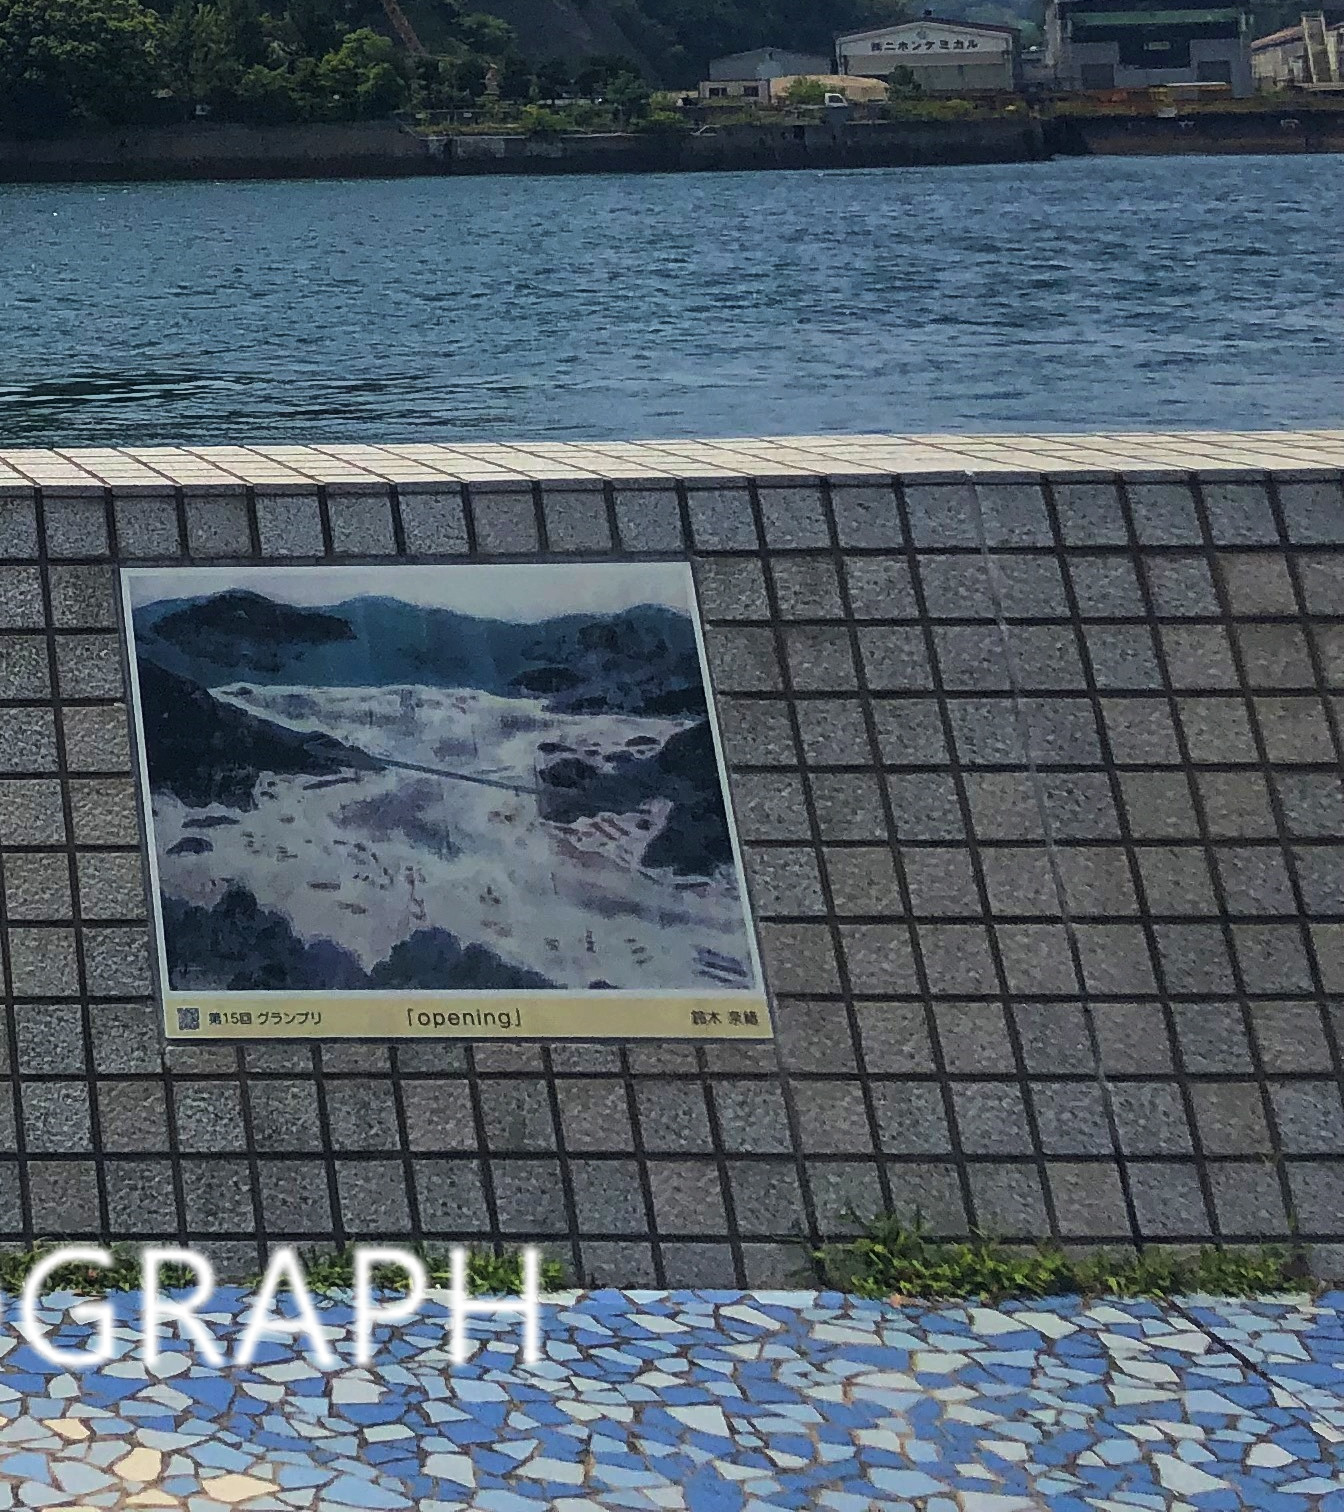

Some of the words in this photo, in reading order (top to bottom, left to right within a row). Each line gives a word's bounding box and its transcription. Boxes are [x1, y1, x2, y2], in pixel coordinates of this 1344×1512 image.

[257, 1012, 322, 1025] グランプリ
